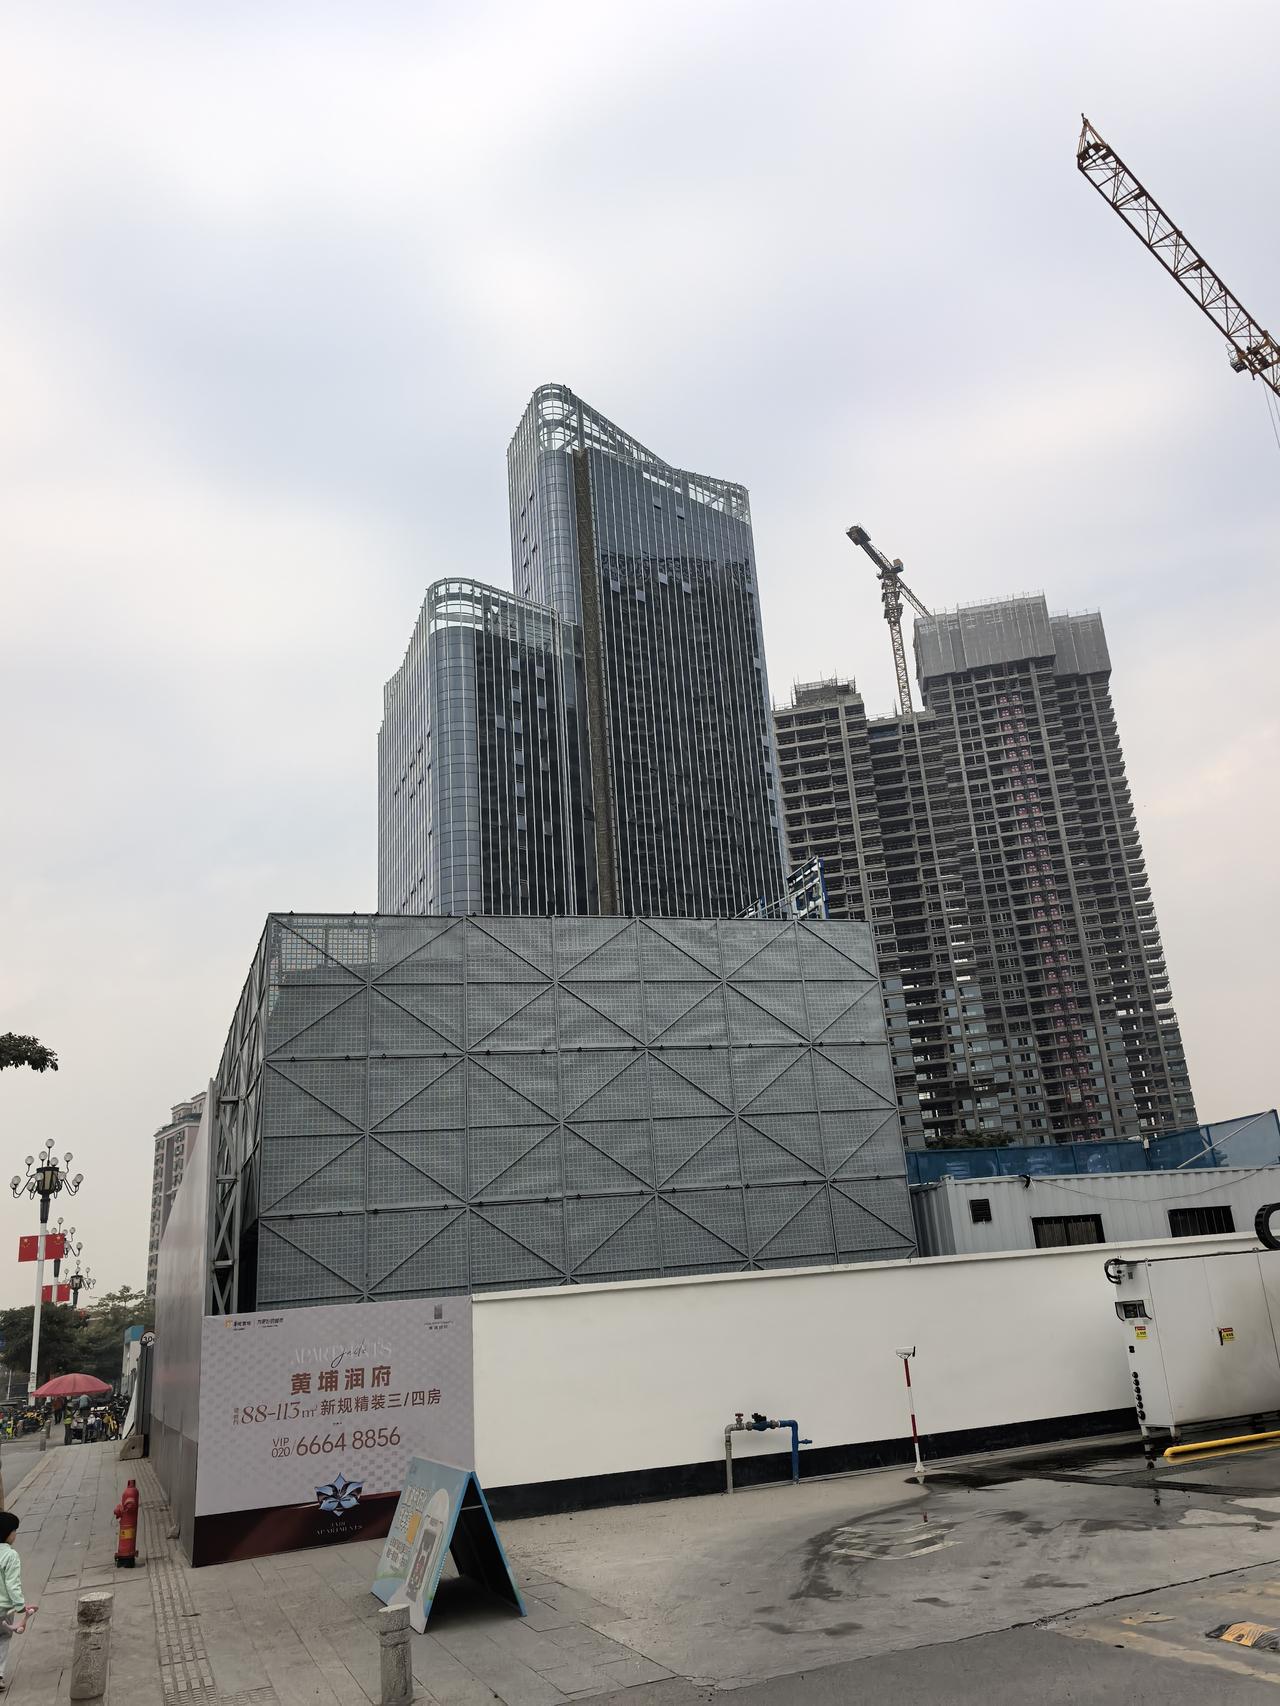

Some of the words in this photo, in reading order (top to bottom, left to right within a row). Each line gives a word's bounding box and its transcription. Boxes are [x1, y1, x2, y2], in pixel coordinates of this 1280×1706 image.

[290, 1365, 391, 1395] 黄埔润府
[271, 1446, 290, 1458] 020
[297, 1431, 346, 1456] 6664
[352, 1427, 400, 1449] 8856
[272, 1437, 289, 1447] VIP
